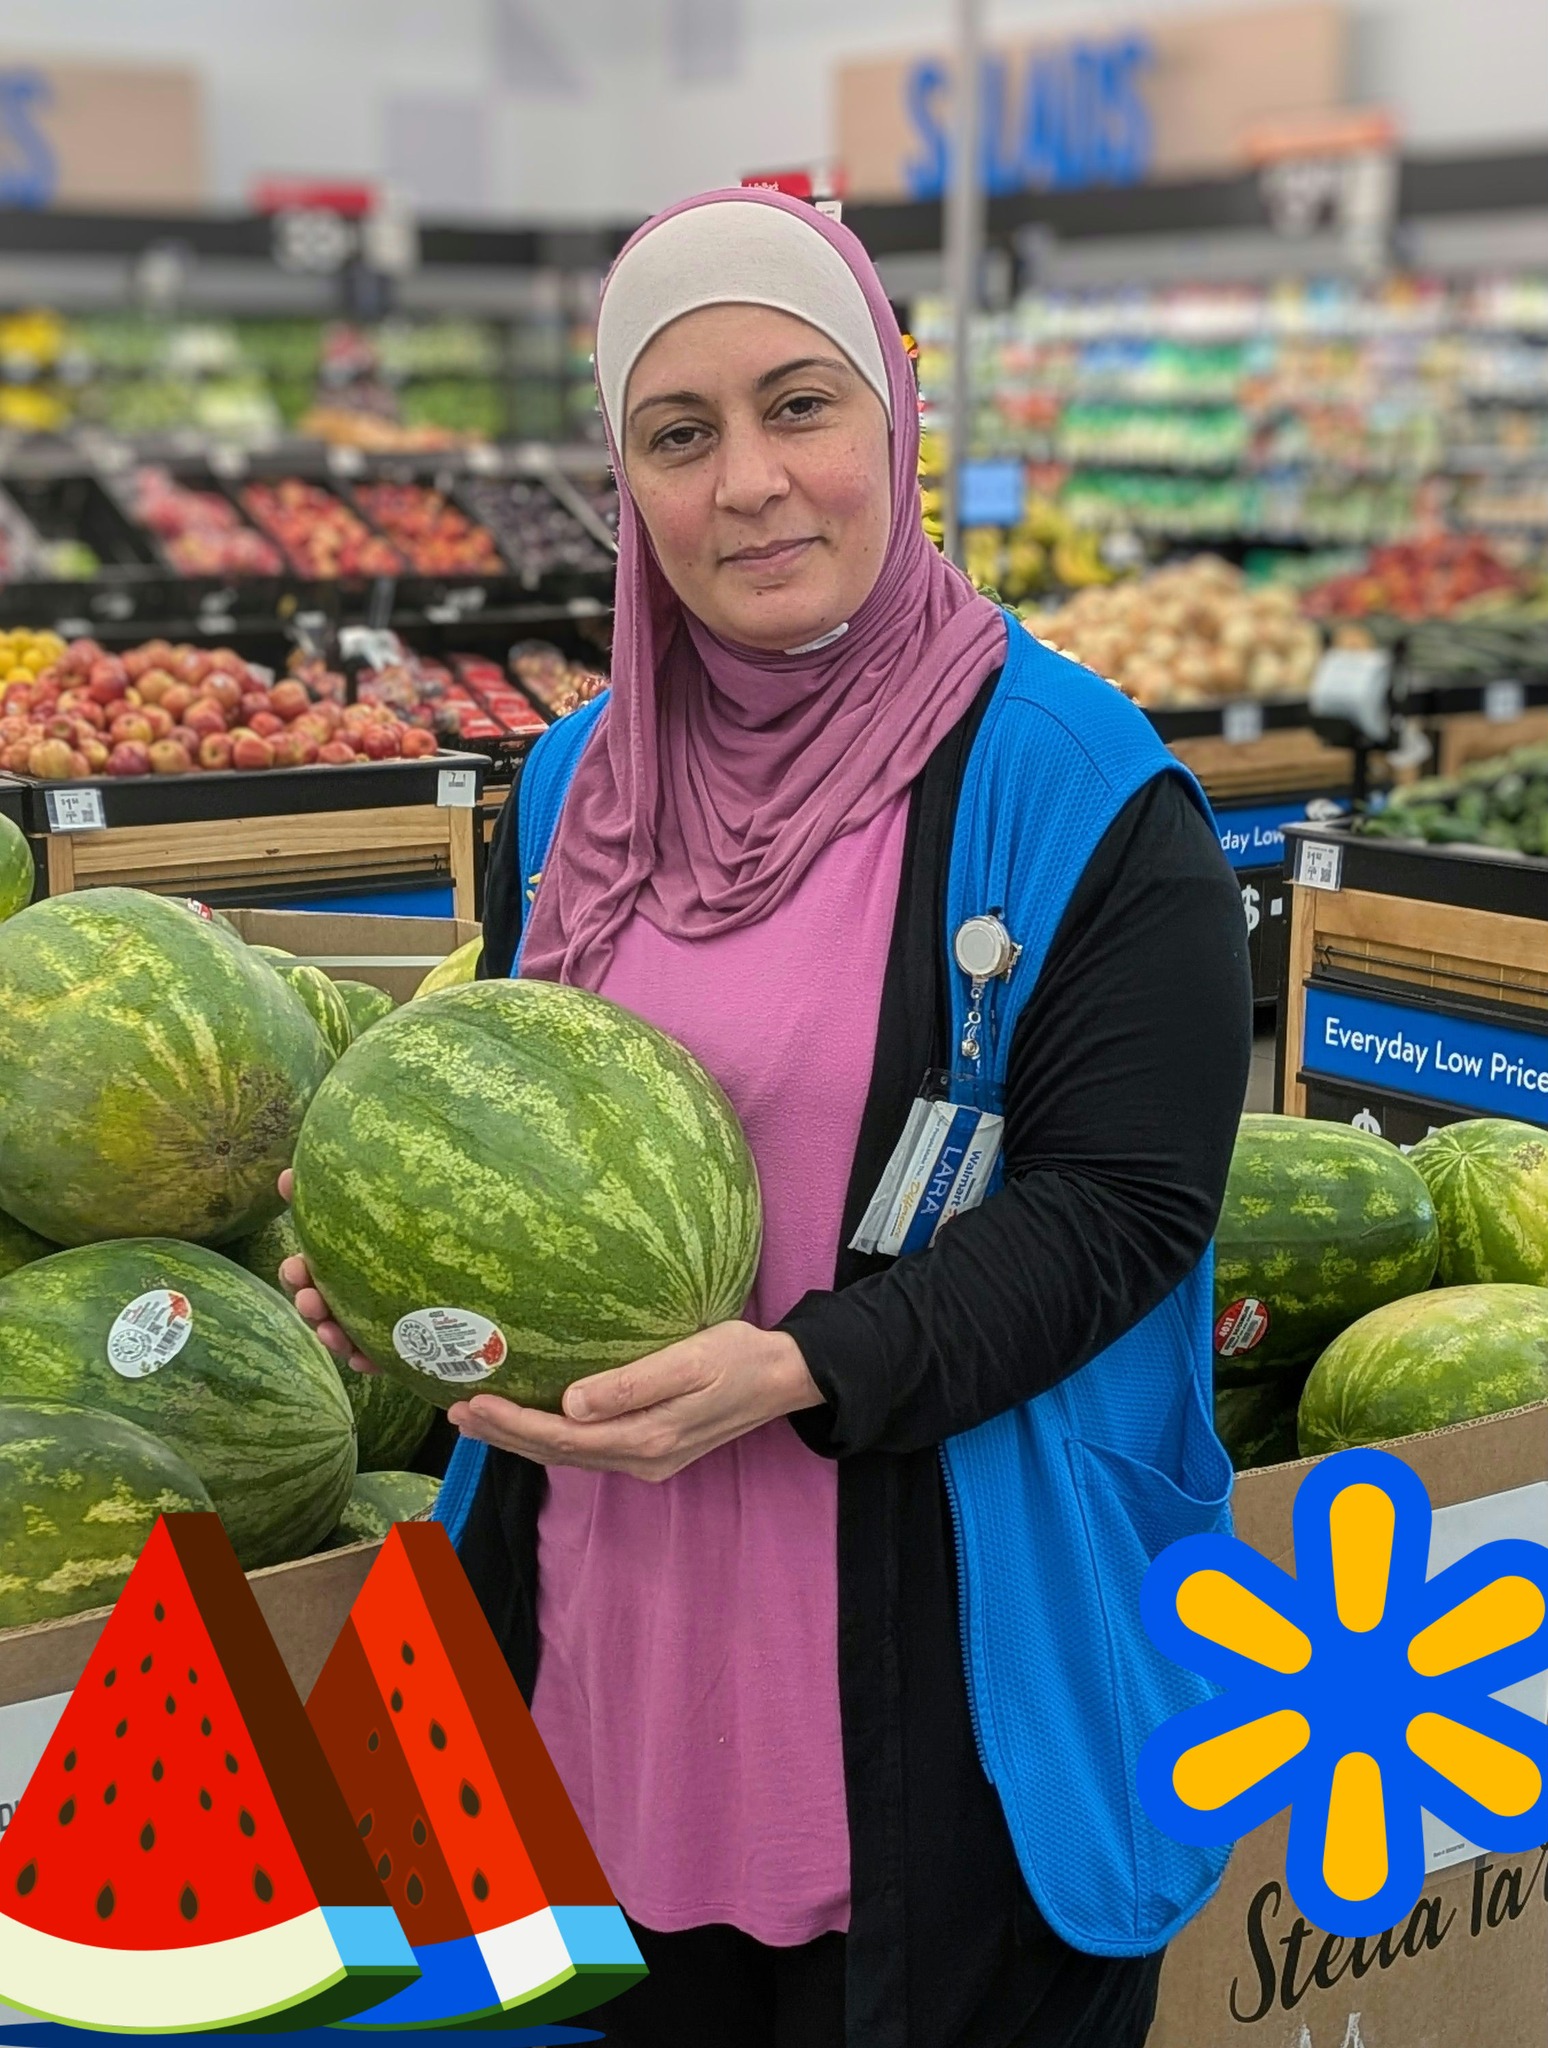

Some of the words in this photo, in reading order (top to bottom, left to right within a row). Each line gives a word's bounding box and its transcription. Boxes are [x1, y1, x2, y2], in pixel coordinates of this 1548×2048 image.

[1325, 1016, 1429, 1074] Everyday
[1435, 1040, 1483, 1078] Low
[920, 1146, 964, 1214] LARA
[950, 1150, 983, 1207] Walmart
[894, 1181, 920, 1239] Difference
